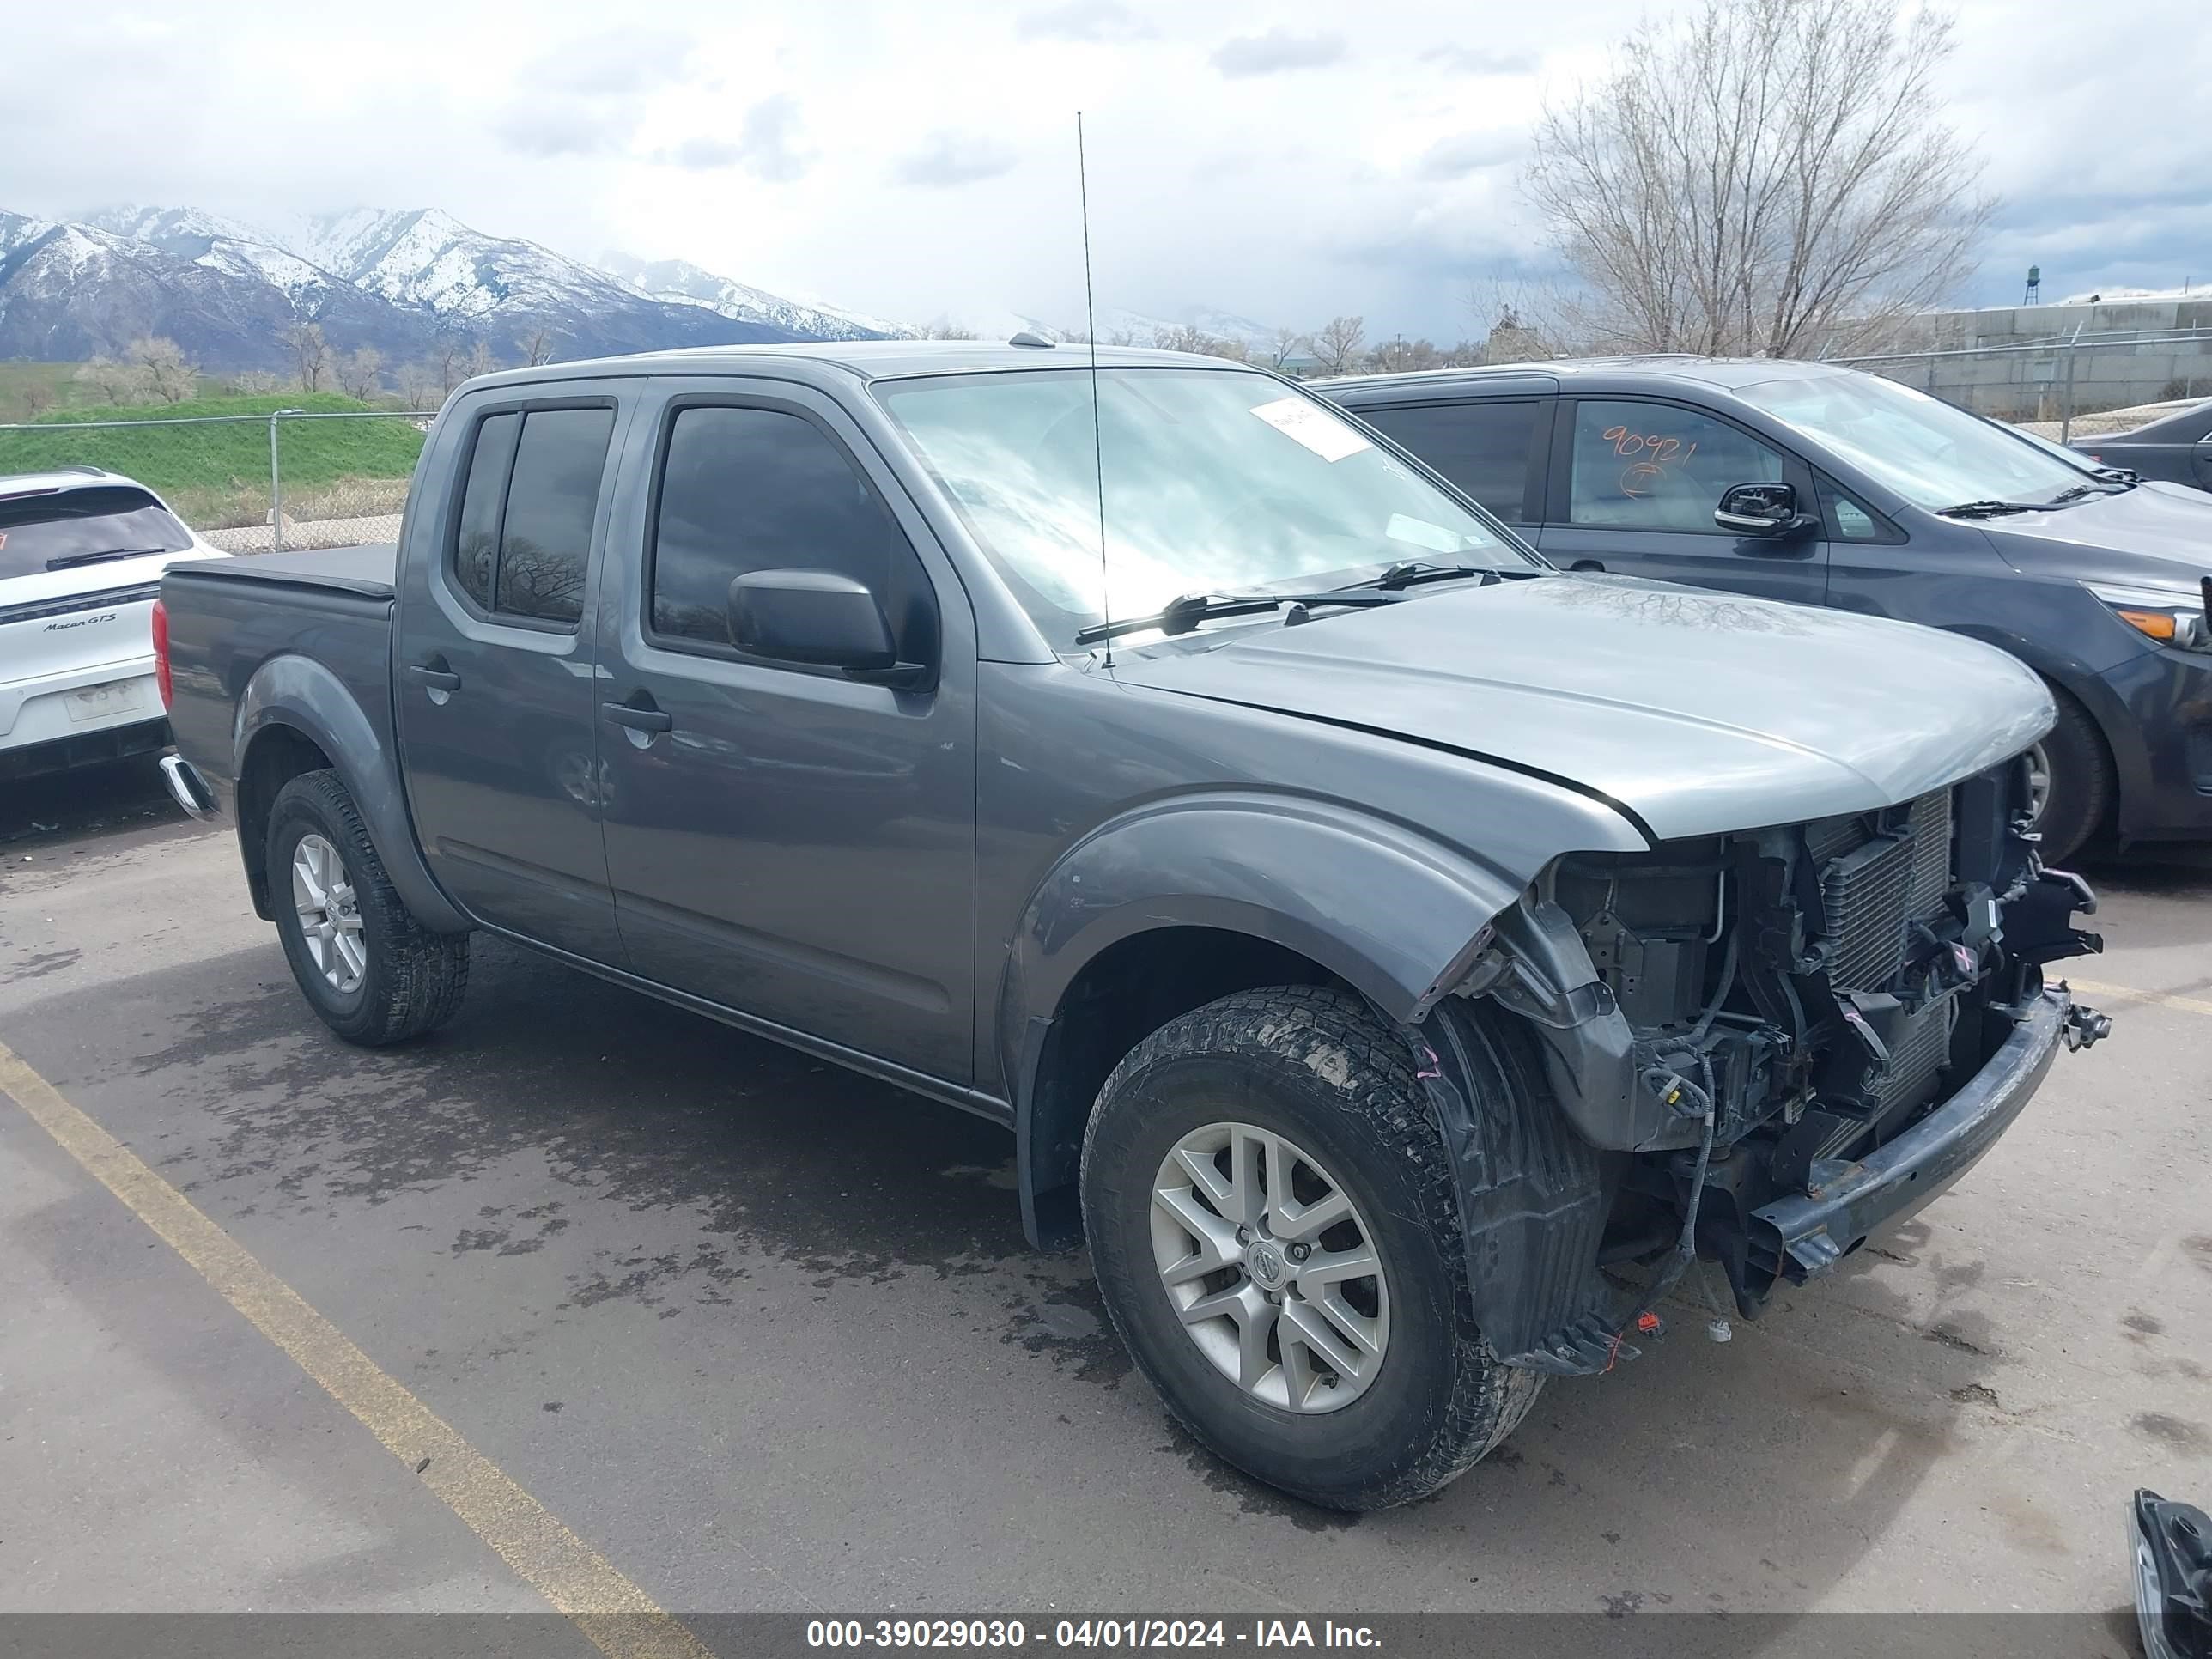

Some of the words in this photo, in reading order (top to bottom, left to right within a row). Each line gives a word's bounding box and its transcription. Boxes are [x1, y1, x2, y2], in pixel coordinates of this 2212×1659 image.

[1602, 425, 1697, 467] 90921
[43, 621, 85, 633] Macan
[88, 613, 118, 624] GTS
